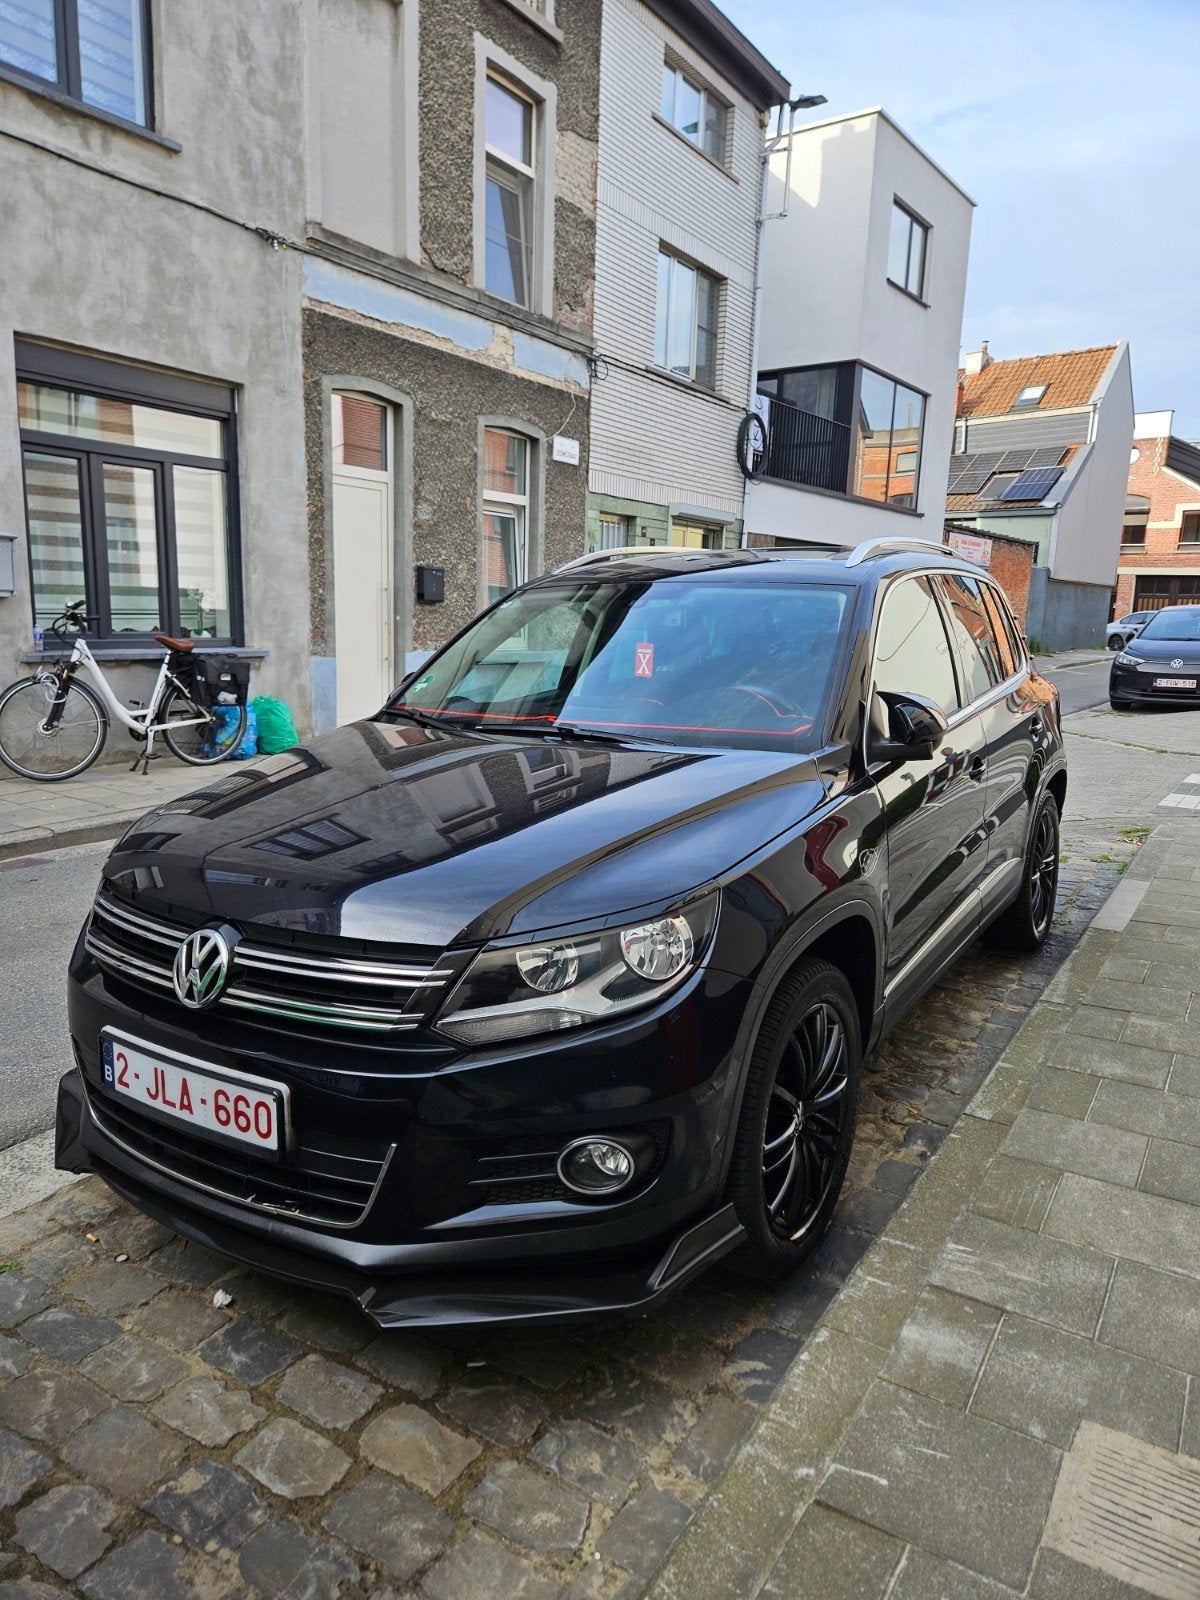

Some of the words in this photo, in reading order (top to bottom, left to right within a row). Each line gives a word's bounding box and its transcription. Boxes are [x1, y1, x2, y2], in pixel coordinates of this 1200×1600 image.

[173, 928, 229, 1009] VW
[104, 1065, 113, 1082] B
[116, 1052, 272, 1140] 2-JLA-660
